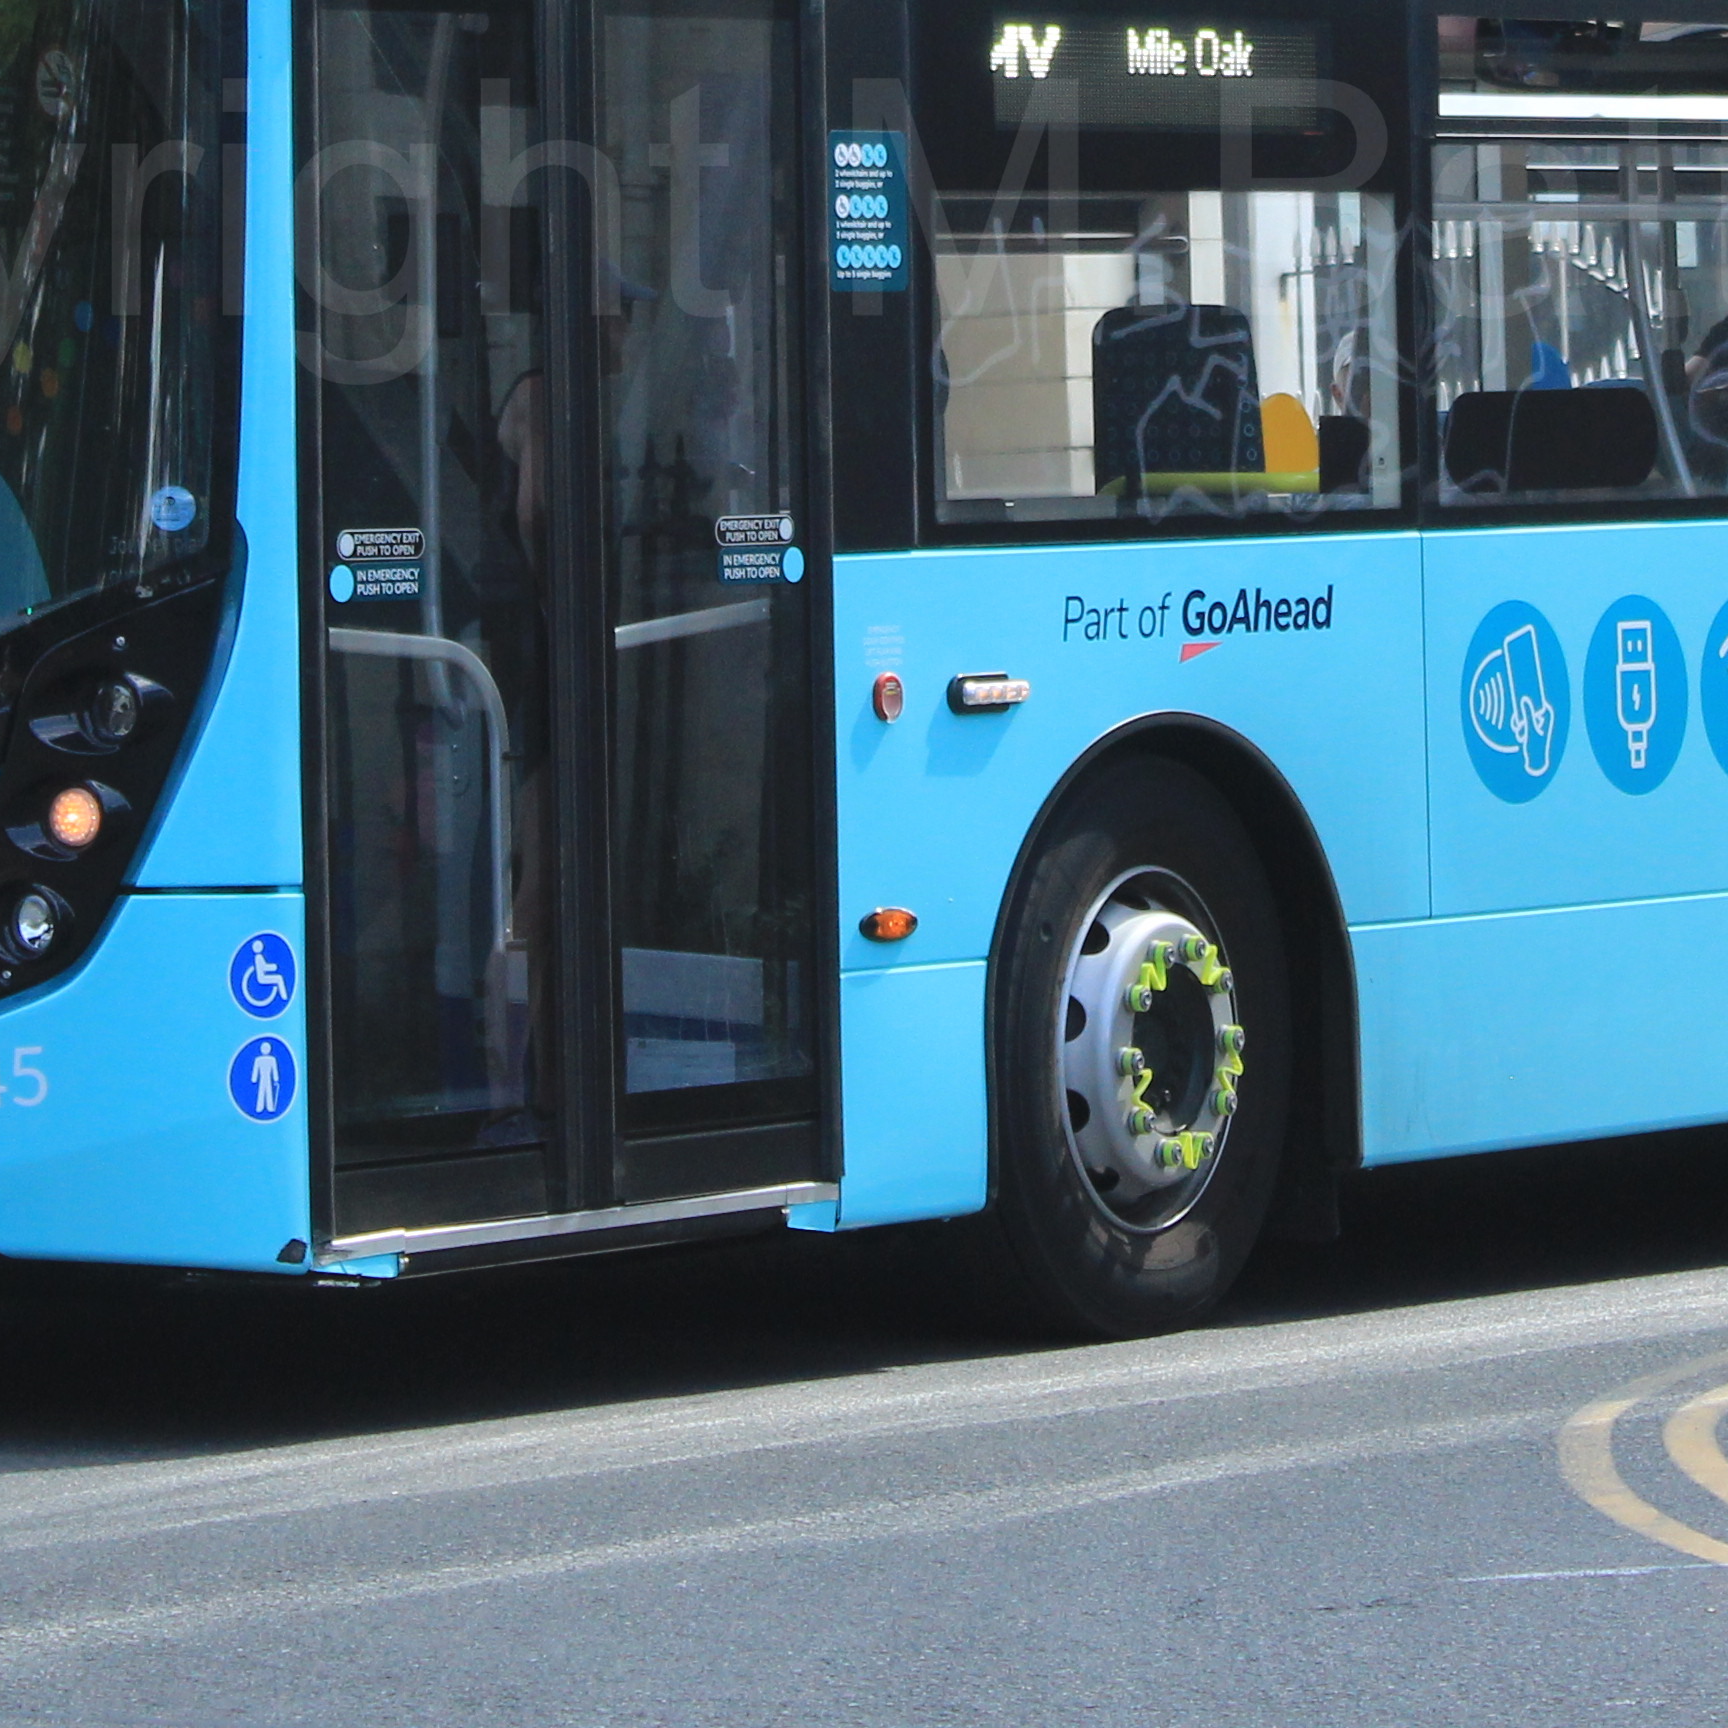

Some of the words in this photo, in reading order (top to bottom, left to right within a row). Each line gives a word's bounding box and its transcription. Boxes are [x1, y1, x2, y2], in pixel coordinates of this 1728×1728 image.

[720, 520, 763, 531] EMERGENCY
[764, 519, 780, 529] EXIT
[354, 533, 401, 544] EMERGENCY
[402, 533, 420, 543] EXIT
[726, 532, 745, 542] PUSH
[746, 531, 757, 541] TO
[758, 531, 778, 541] OPEN
[357, 545, 378, 556] PUSH
[379, 545, 391, 556] TO
[392, 545, 414, 555] OPEN
[723, 554, 732, 566] IN
[733, 553, 780, 565] EMERGENCY
[357, 570, 366, 582] IN
[367, 568, 420, 581] EMERGENCY
[724, 568, 746, 580] PUSH
[746, 567, 757, 579] TO
[758, 566, 780, 578] OPEN
[357, 583, 380, 595] PUSH
[381, 583, 393, 595] TO
[394, 582, 418, 594] OPEN
[1063, 594, 1128, 643] Part
[1138, 592, 1172, 638] of
[1181, 584, 1334, 636] GoAhead
